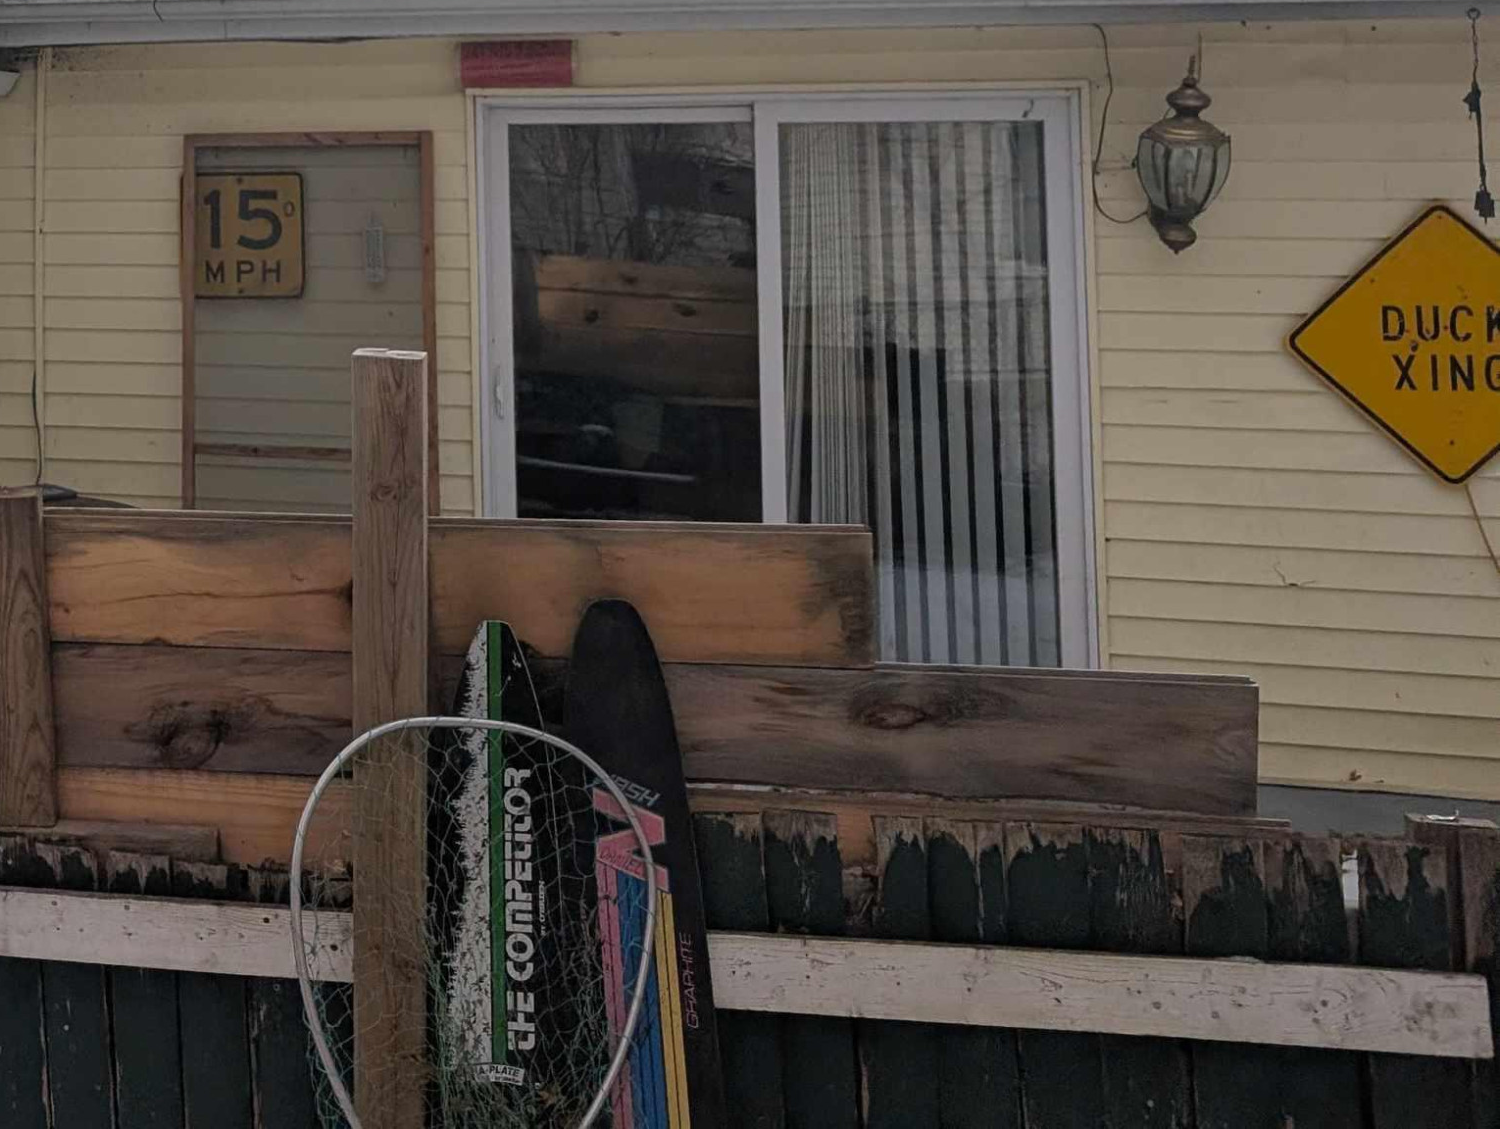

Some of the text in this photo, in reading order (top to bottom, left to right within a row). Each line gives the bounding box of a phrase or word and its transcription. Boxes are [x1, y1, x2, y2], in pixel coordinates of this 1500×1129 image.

[204, 259, 281, 283] MPH
[1381, 304, 1500, 344] DUCK
[1391, 353, 1500, 392] XING
[504, 768, 536, 1051] THE COMPETITOR
[678, 932, 699, 1029] GRAPHITE
